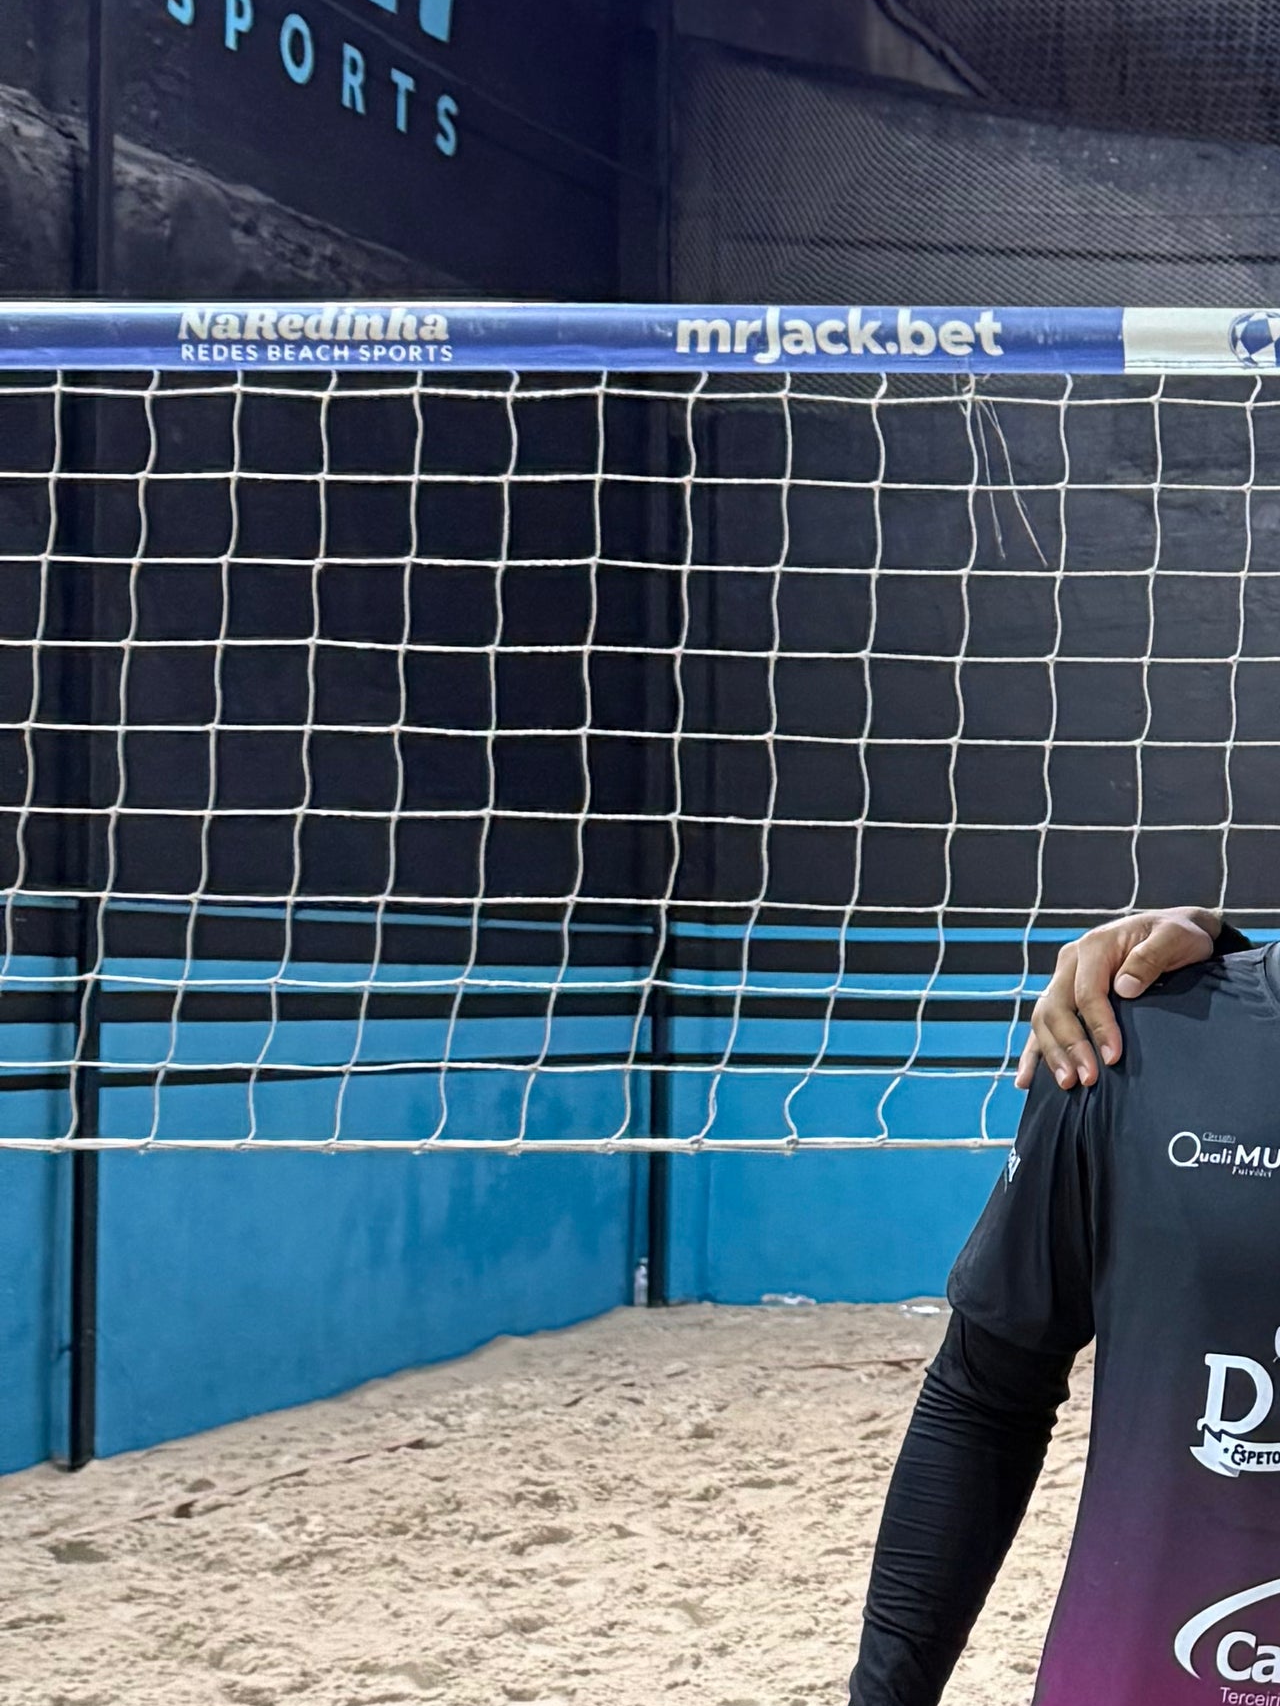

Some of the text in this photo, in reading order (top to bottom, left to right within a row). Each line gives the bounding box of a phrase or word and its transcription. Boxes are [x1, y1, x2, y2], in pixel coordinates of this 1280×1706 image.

[177, 307, 449, 341] NaRedinha
[181, 344, 453, 361] REDES BEACH SPORTS
